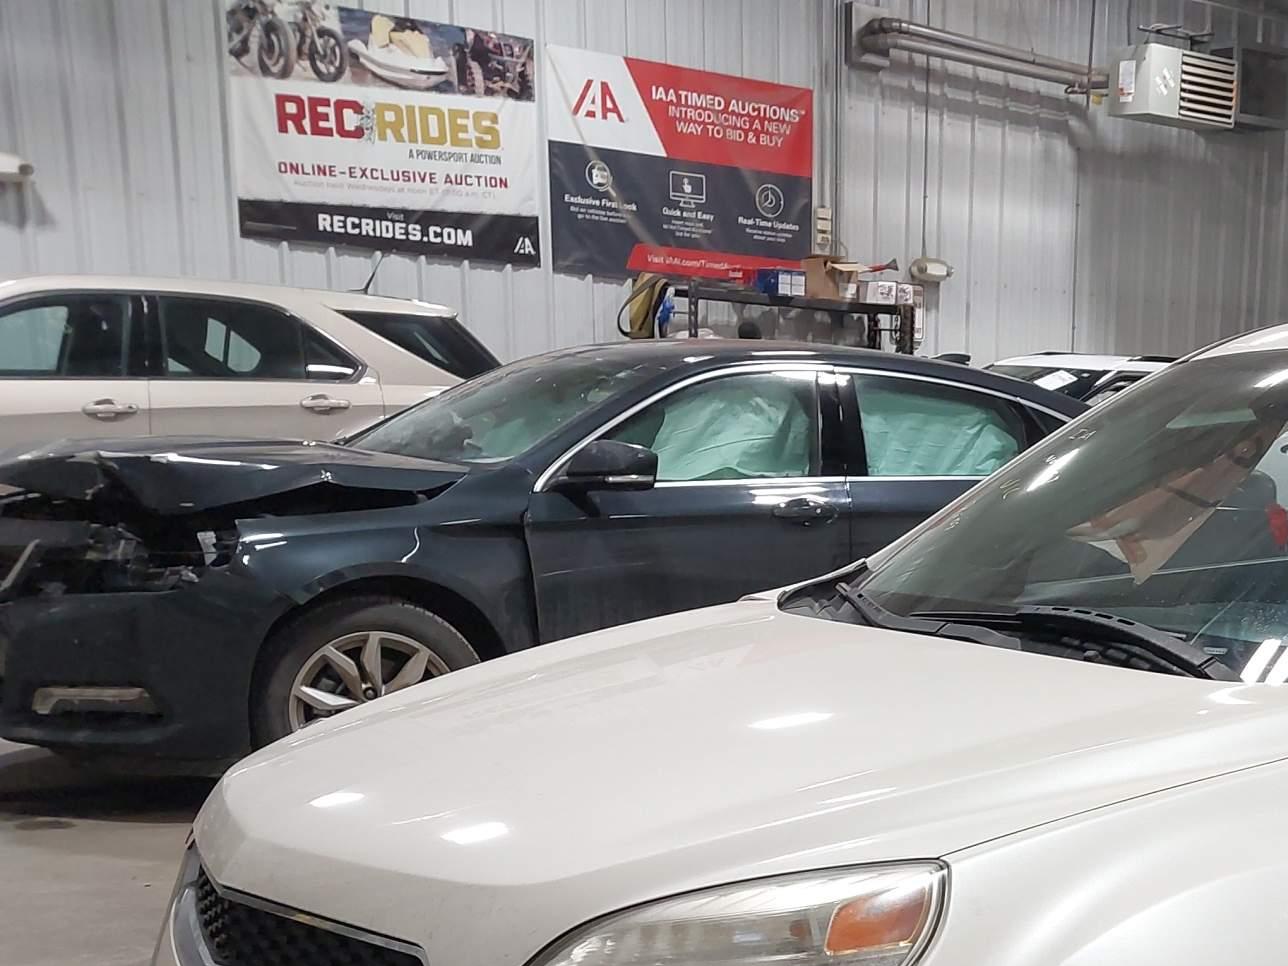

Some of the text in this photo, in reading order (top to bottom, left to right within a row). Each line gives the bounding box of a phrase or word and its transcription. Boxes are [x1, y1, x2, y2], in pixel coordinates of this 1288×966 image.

[651, 85, 677, 103] IAA
[678, 90, 725, 110] TIMED
[668, 105, 792, 135] INTRODUCING A NEW
[675, 121, 784, 148] WAY TO BID & BUY
[408, 149, 502, 165] A POWERSPORT AUCTION
[278, 161, 509, 189] ONLINE-EXCLUSIVE AUCTION
[564, 194, 600, 207] Exclusive
[386, 211, 404, 221] Visit
[662, 206, 715, 222] Quick and Easy
[318, 213, 473, 247] RECRIDES.COM
[738, 216, 800, 231] Real-Time Updates
[647, 254, 664, 265] Visit
